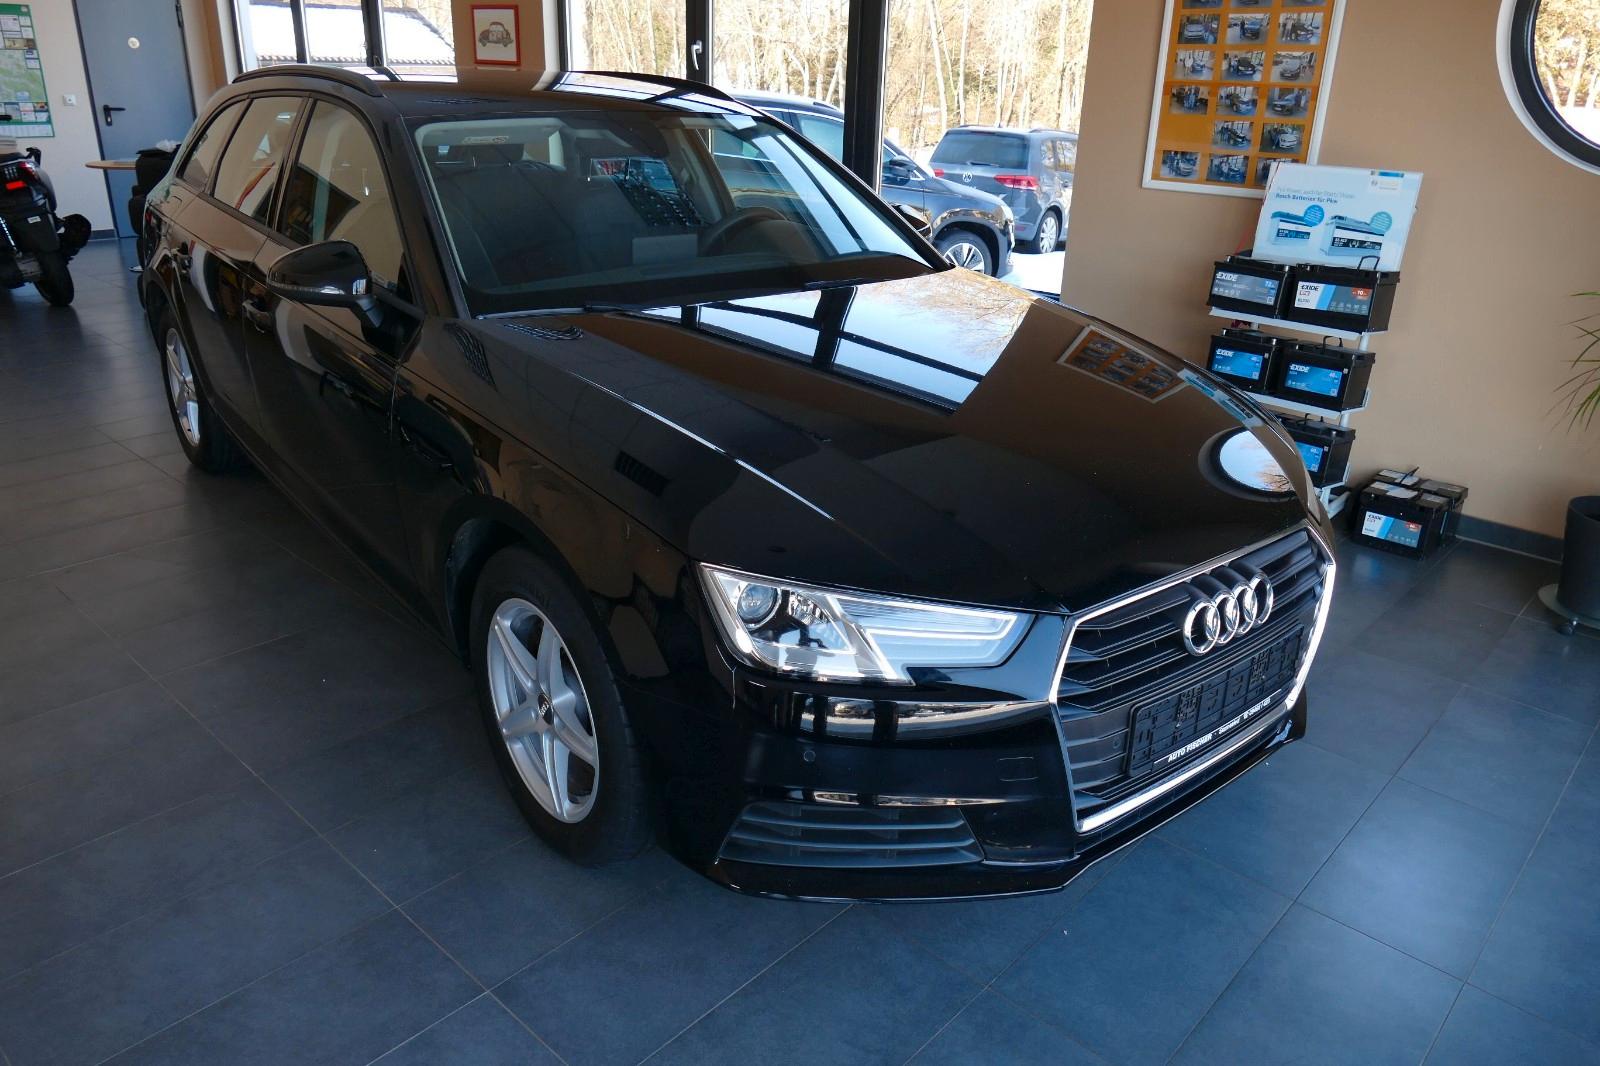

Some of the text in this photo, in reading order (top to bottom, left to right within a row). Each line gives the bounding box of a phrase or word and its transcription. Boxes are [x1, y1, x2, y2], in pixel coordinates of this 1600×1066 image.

[1216, 271, 1239, 282] EXIDE
[1301, 284, 1320, 292] EXIDE
[1289, 363, 1310, 374] EXIDE
[1168, 747, 1186, 763] AUTO
